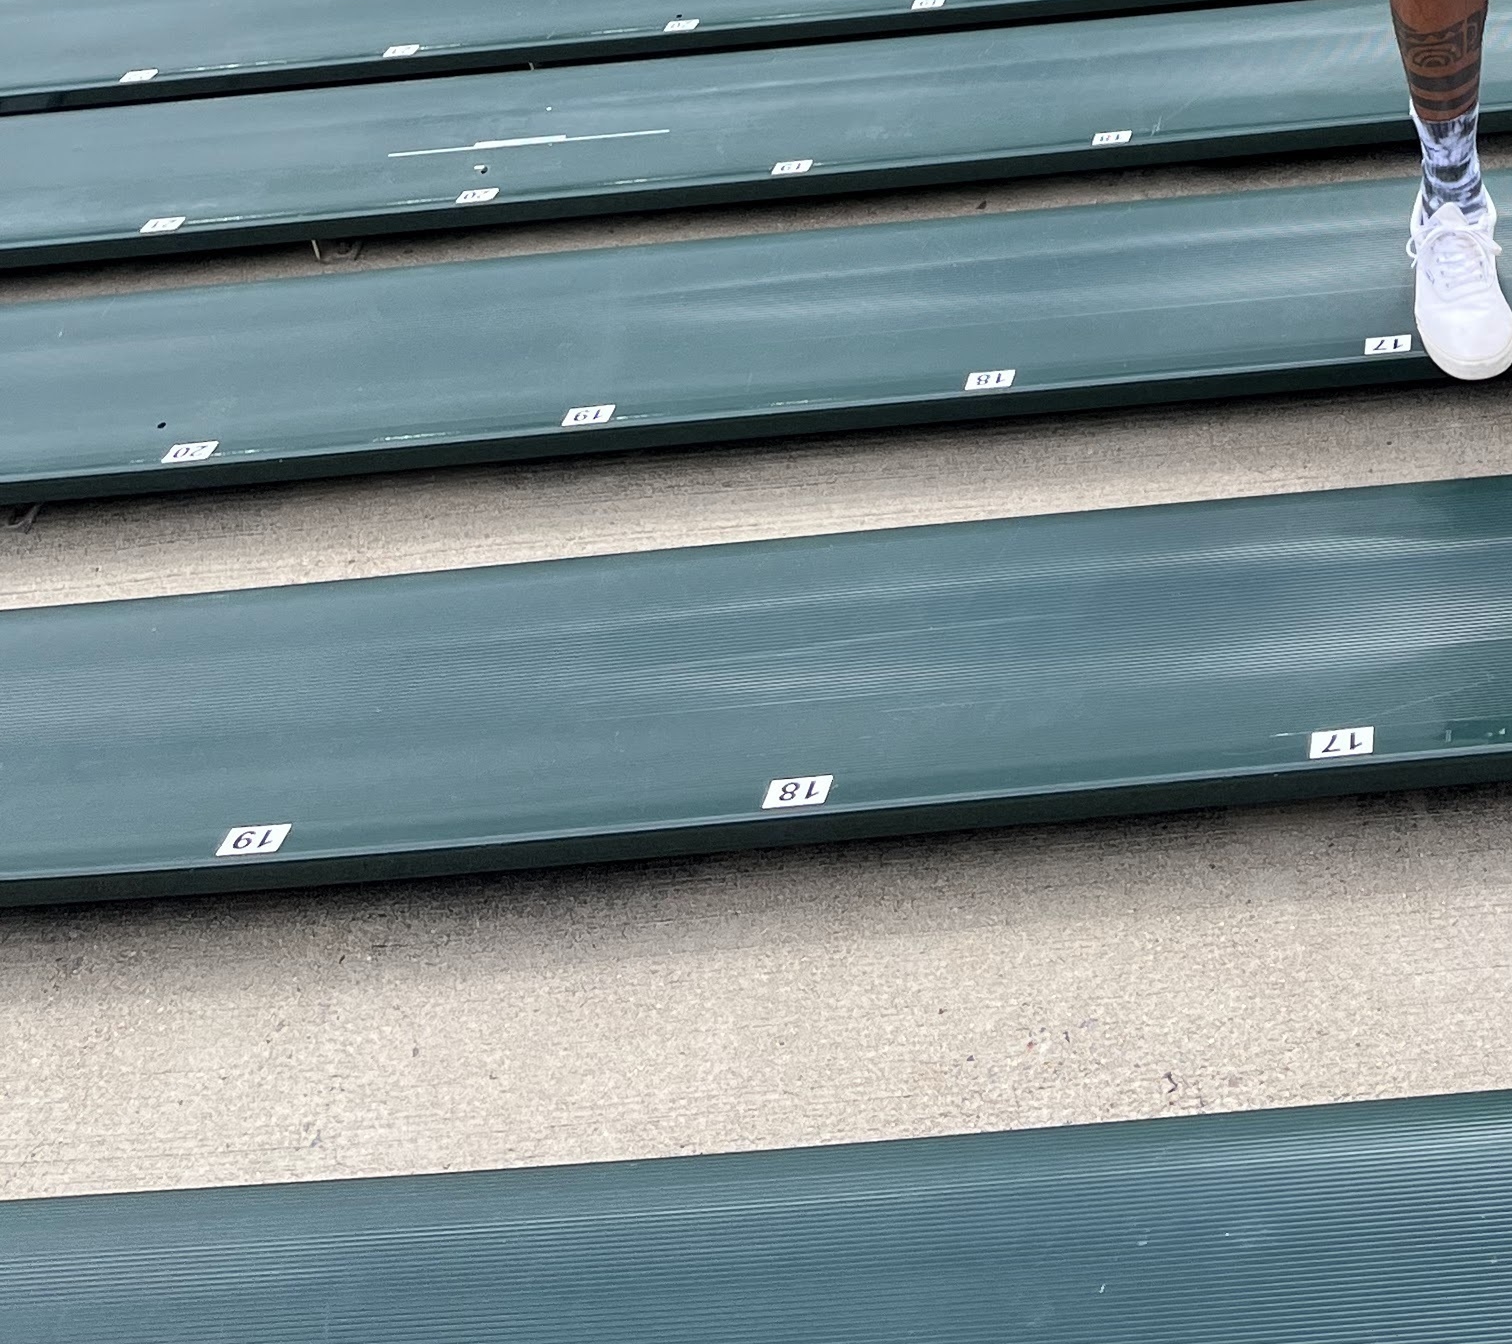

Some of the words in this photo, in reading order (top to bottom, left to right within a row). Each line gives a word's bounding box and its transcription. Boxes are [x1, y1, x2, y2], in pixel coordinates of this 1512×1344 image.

[1373, 338, 1404, 351] 17
[977, 372, 1005, 385] 18
[574, 410, 603, 422] 19
[173, 445, 207, 458] 20
[1322, 732, 1363, 753] 17
[779, 780, 819, 801] 18
[233, 830, 274, 850] 19
